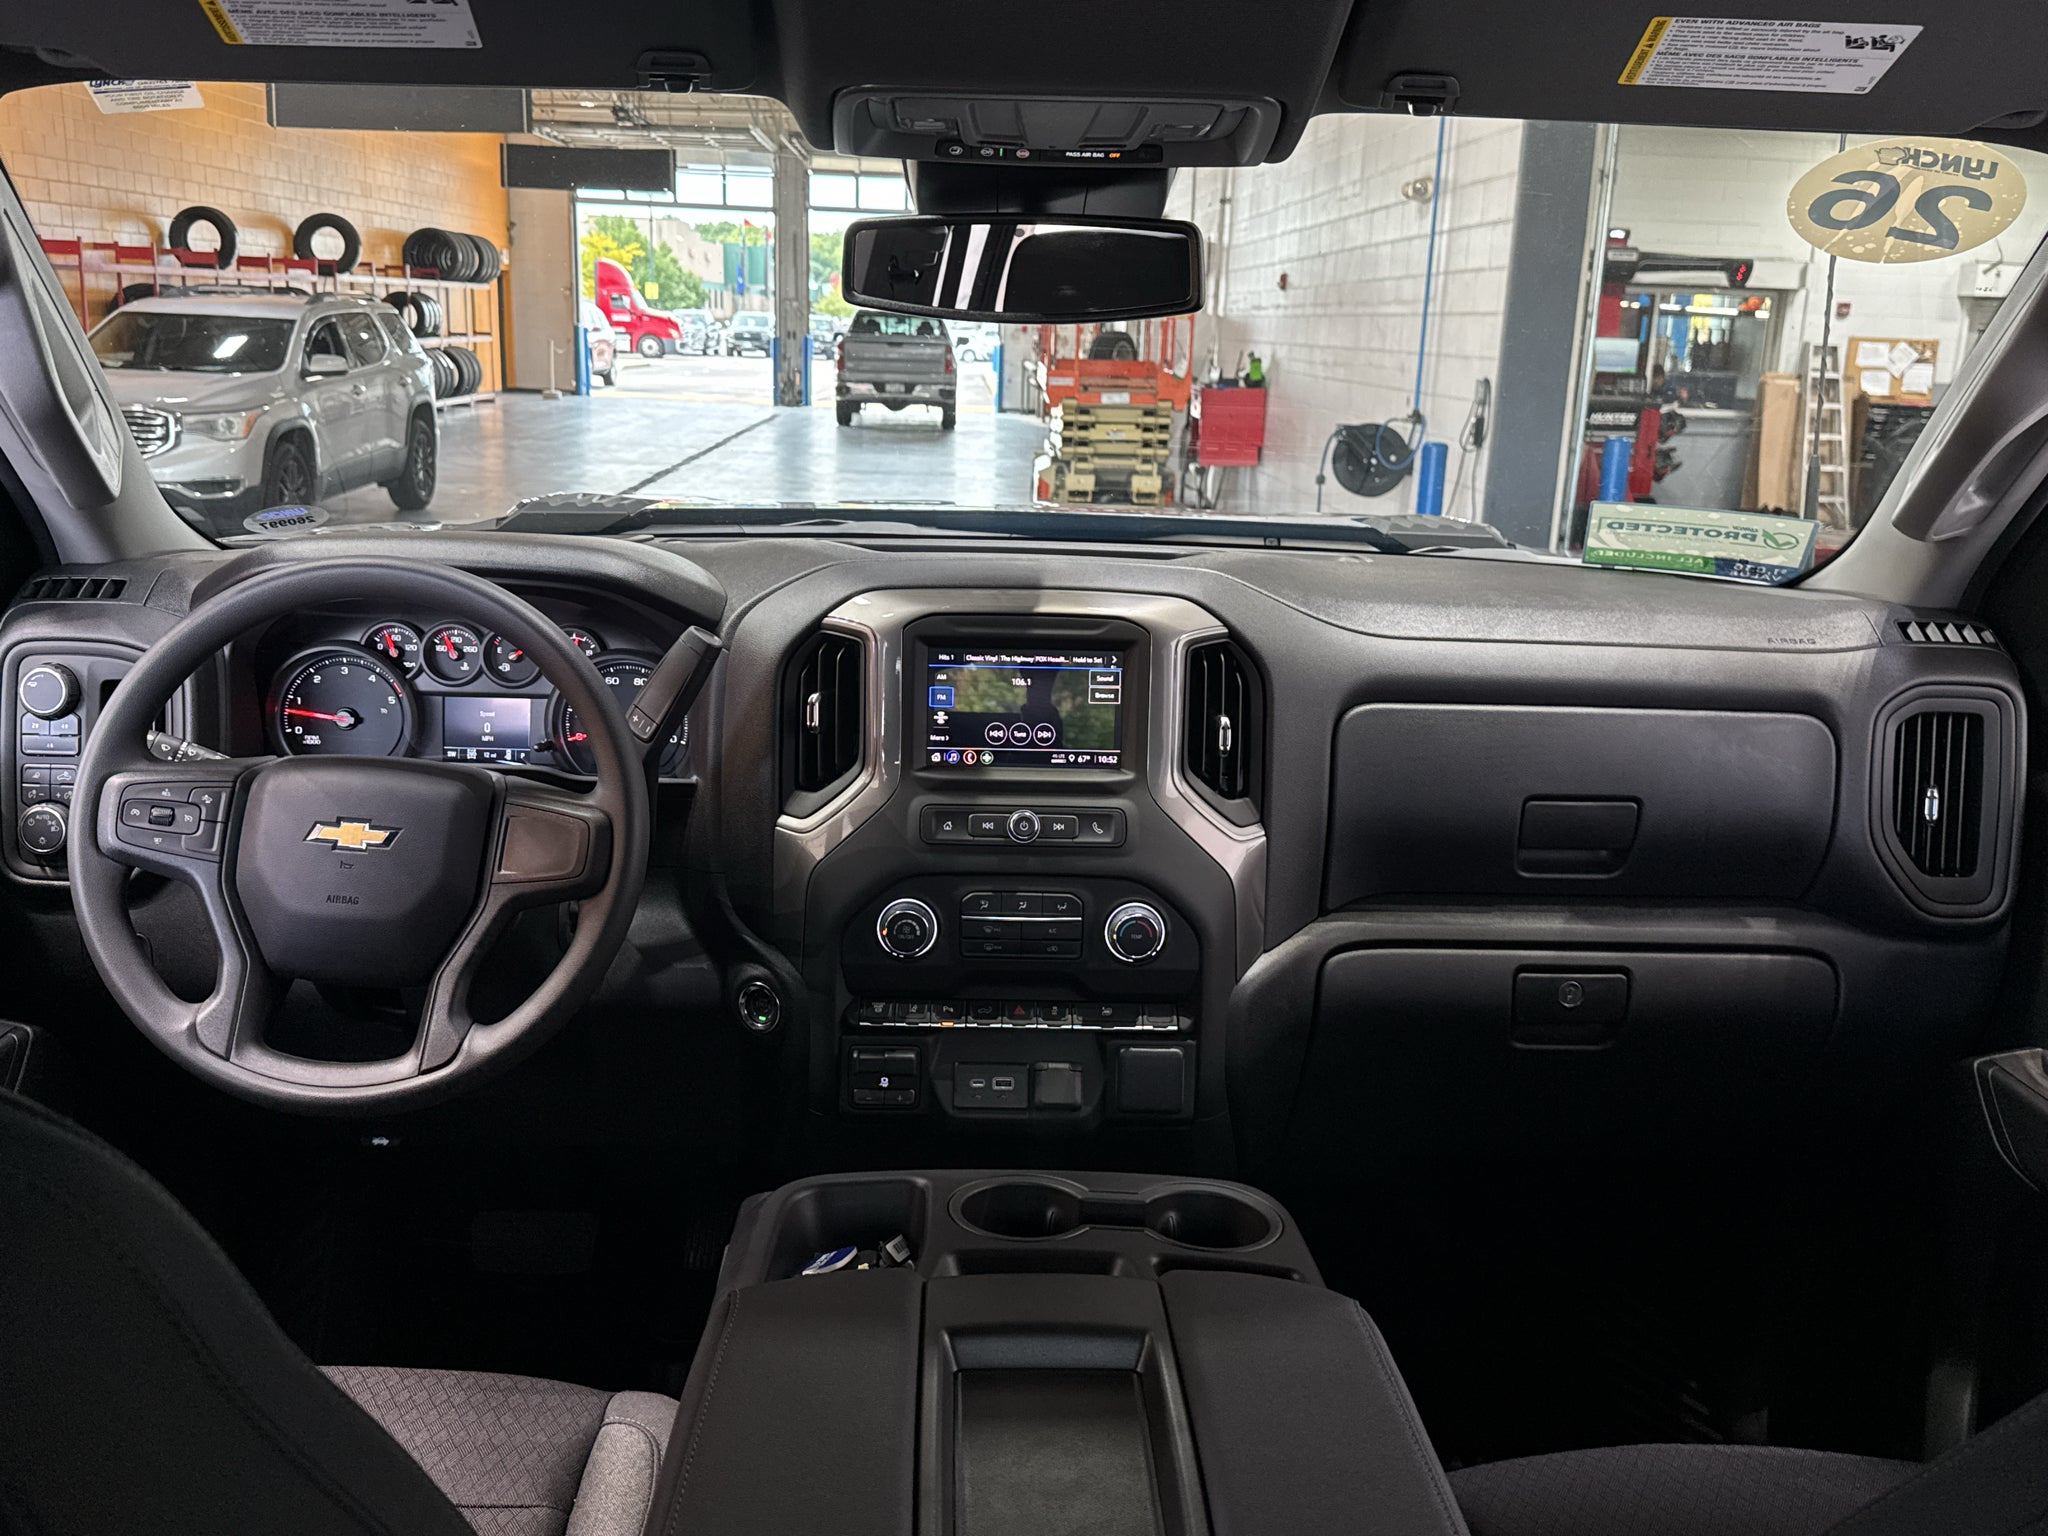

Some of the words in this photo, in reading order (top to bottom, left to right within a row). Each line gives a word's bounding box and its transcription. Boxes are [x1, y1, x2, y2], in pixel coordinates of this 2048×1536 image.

[391, 634, 401, 642] 60
[450, 635, 463, 643] 210
[463, 645, 478, 653] 260
[965, 654, 985, 662] Classic
[985, 655, 999, 663] Vinyl
[1011, 655, 1035, 664] Highway
[341, 667, 349, 675] 3
[313, 675, 322, 684] 2
[368, 675, 377, 683] 4
[605, 676, 620, 685] 60
[1011, 678, 1032, 686] 106.1
[296, 697, 302, 705] 1
[388, 696, 396, 705] 5
[294, 726, 303, 735] 0
[484, 722, 491, 733] 0
[1097, 755, 1118, 764] 10:52
[325, 894, 360, 905] AIRBAG
